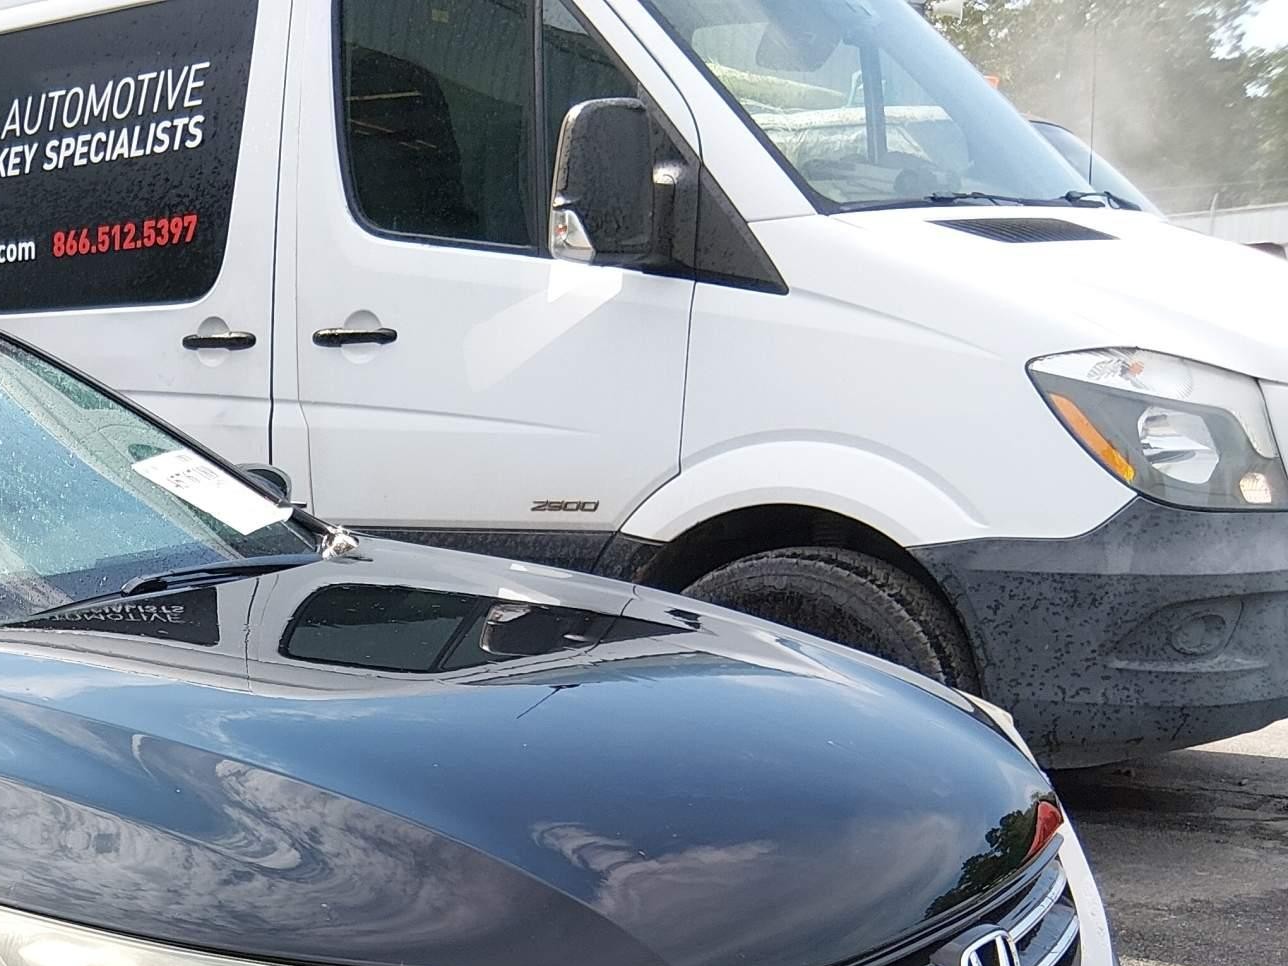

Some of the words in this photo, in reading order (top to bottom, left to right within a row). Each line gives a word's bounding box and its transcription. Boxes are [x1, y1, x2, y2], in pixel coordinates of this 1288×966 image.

[0, 61, 211, 140] AUTOMOTIVE
[42, 114, 206, 171] SPECIALISTS
[51, 214, 198, 258] 866.512.5397
